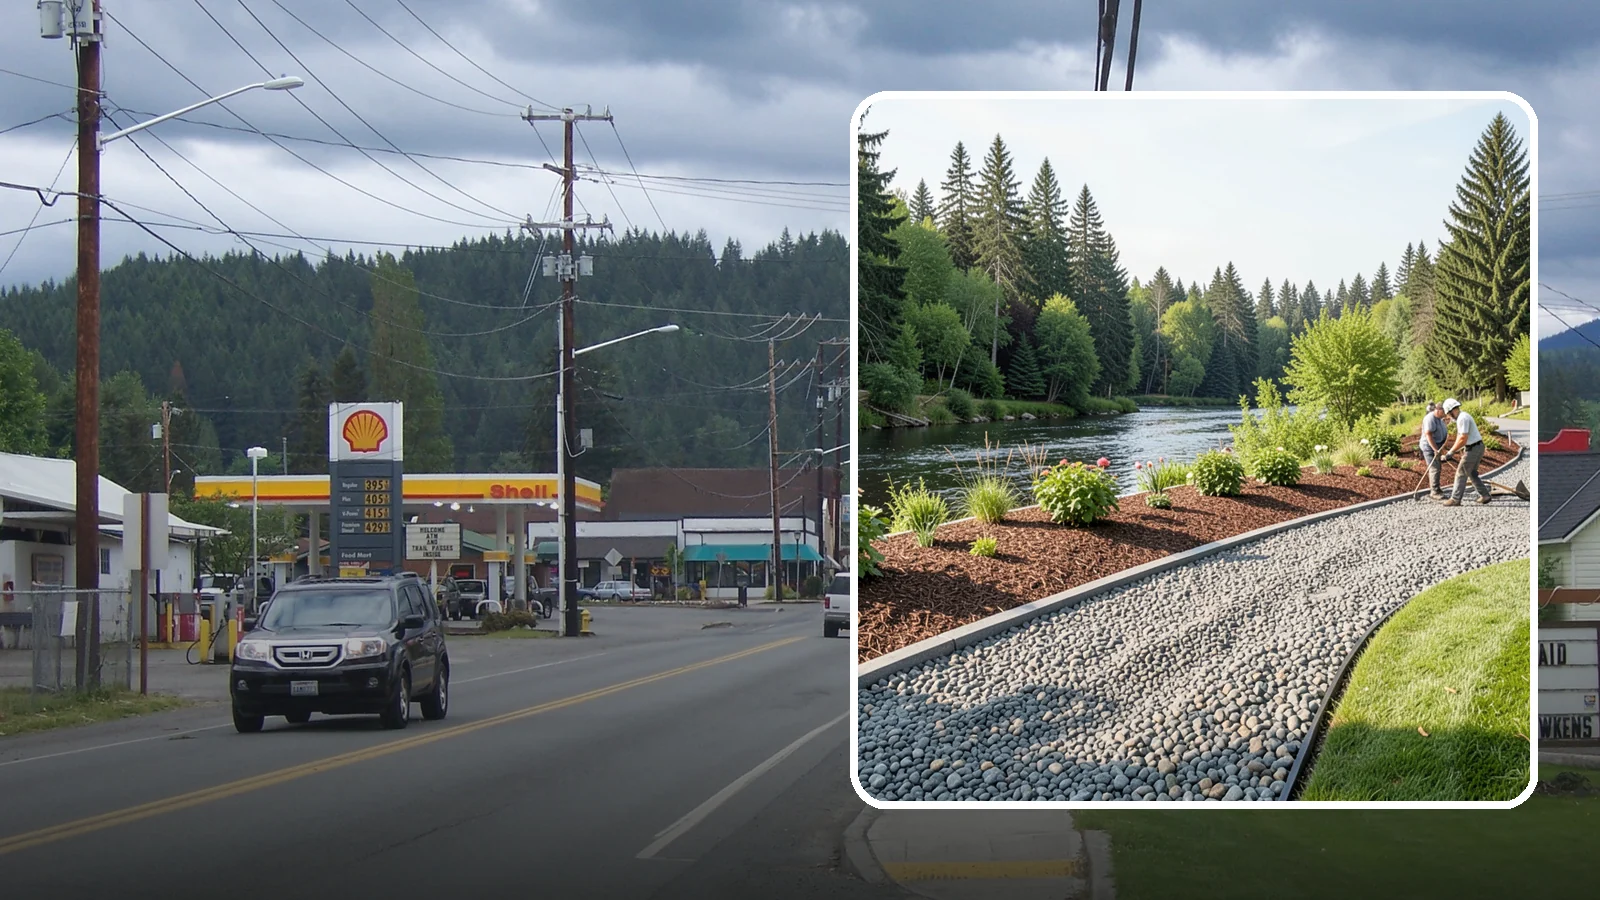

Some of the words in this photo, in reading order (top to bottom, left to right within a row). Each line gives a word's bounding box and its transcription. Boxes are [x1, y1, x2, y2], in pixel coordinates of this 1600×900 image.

[366, 480, 383, 490] 395
[490, 484, 547, 499] Shell
[366, 494, 383, 504] 405
[366, 508, 383, 518] 415
[366, 522, 383, 532] 429
